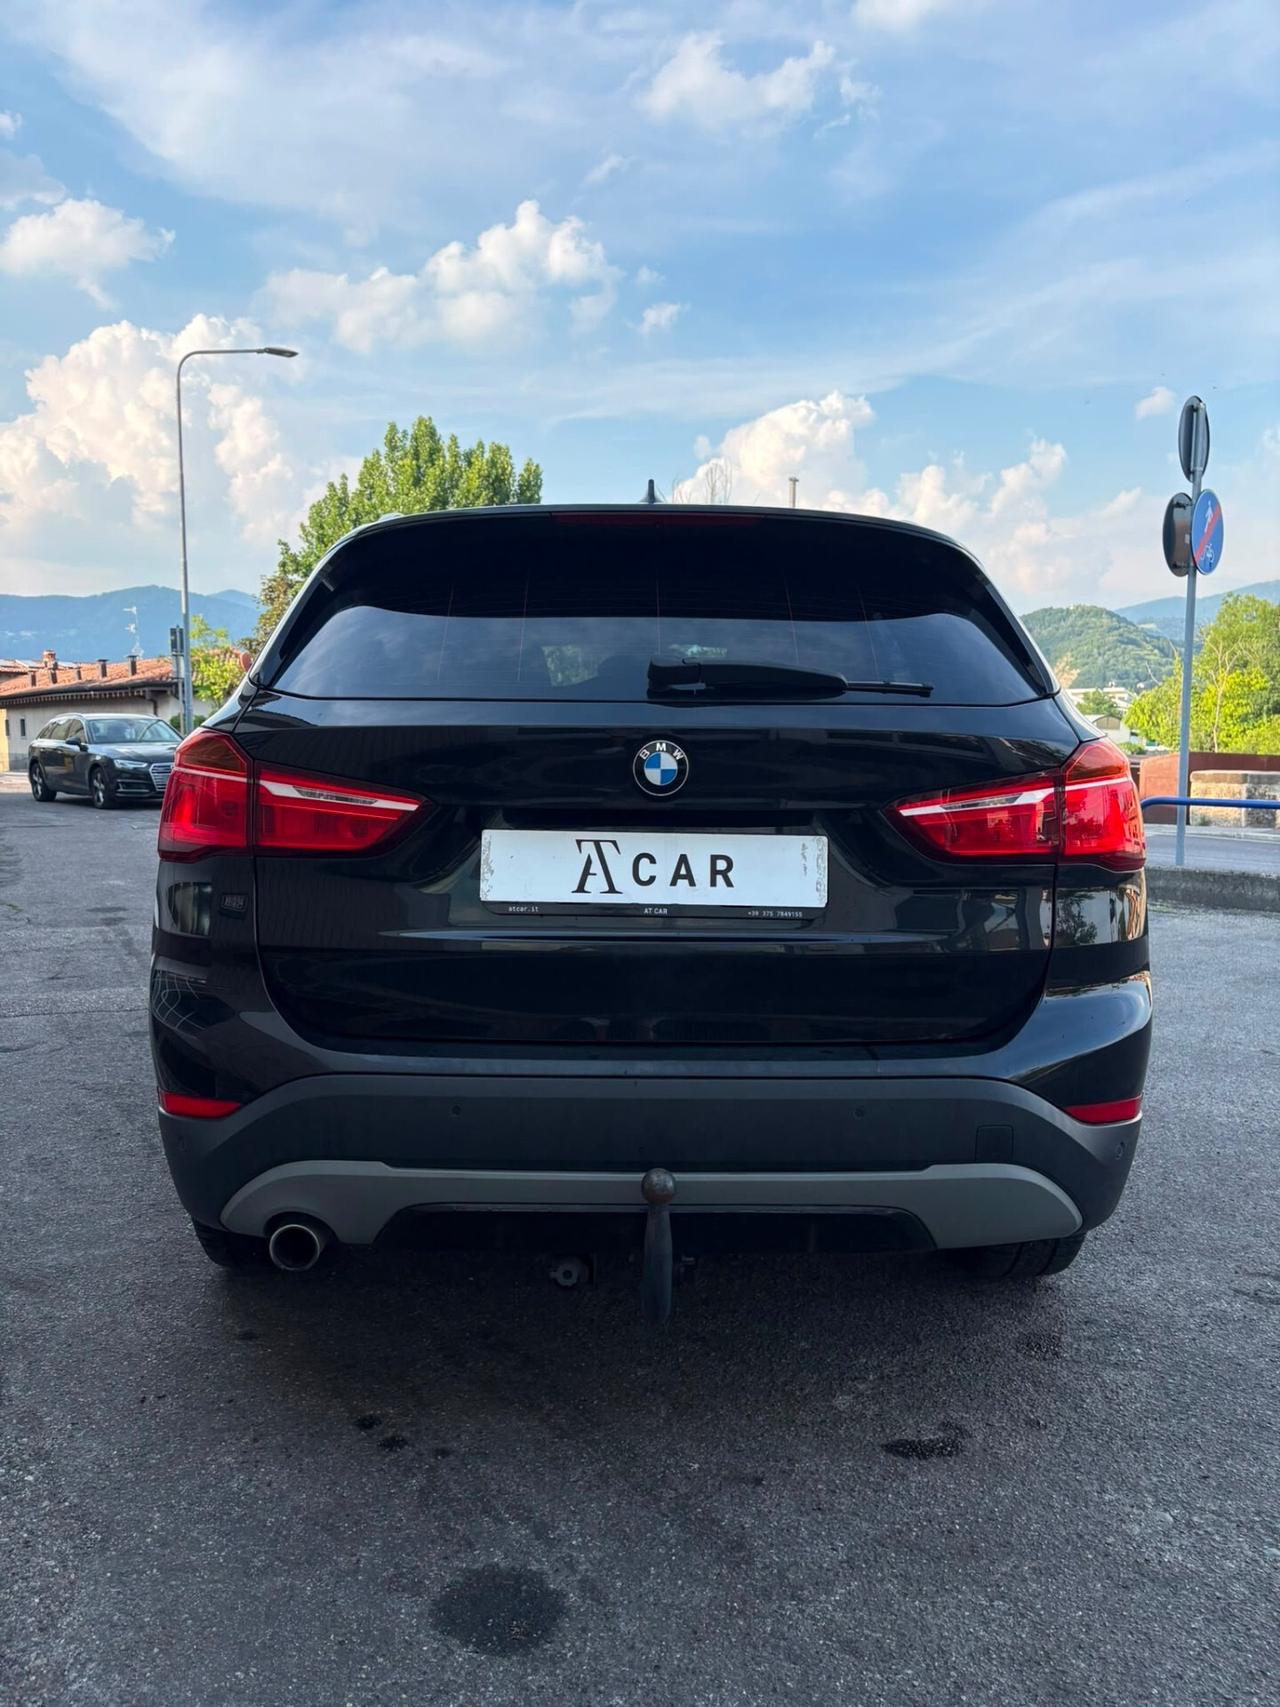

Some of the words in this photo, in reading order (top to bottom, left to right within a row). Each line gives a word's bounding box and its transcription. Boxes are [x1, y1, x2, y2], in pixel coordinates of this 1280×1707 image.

[640, 742, 684, 760] BMW
[632, 852, 734, 888] CAR
[508, 904, 539, 912] atcar.it
[653, 907, 668, 915] CAR
